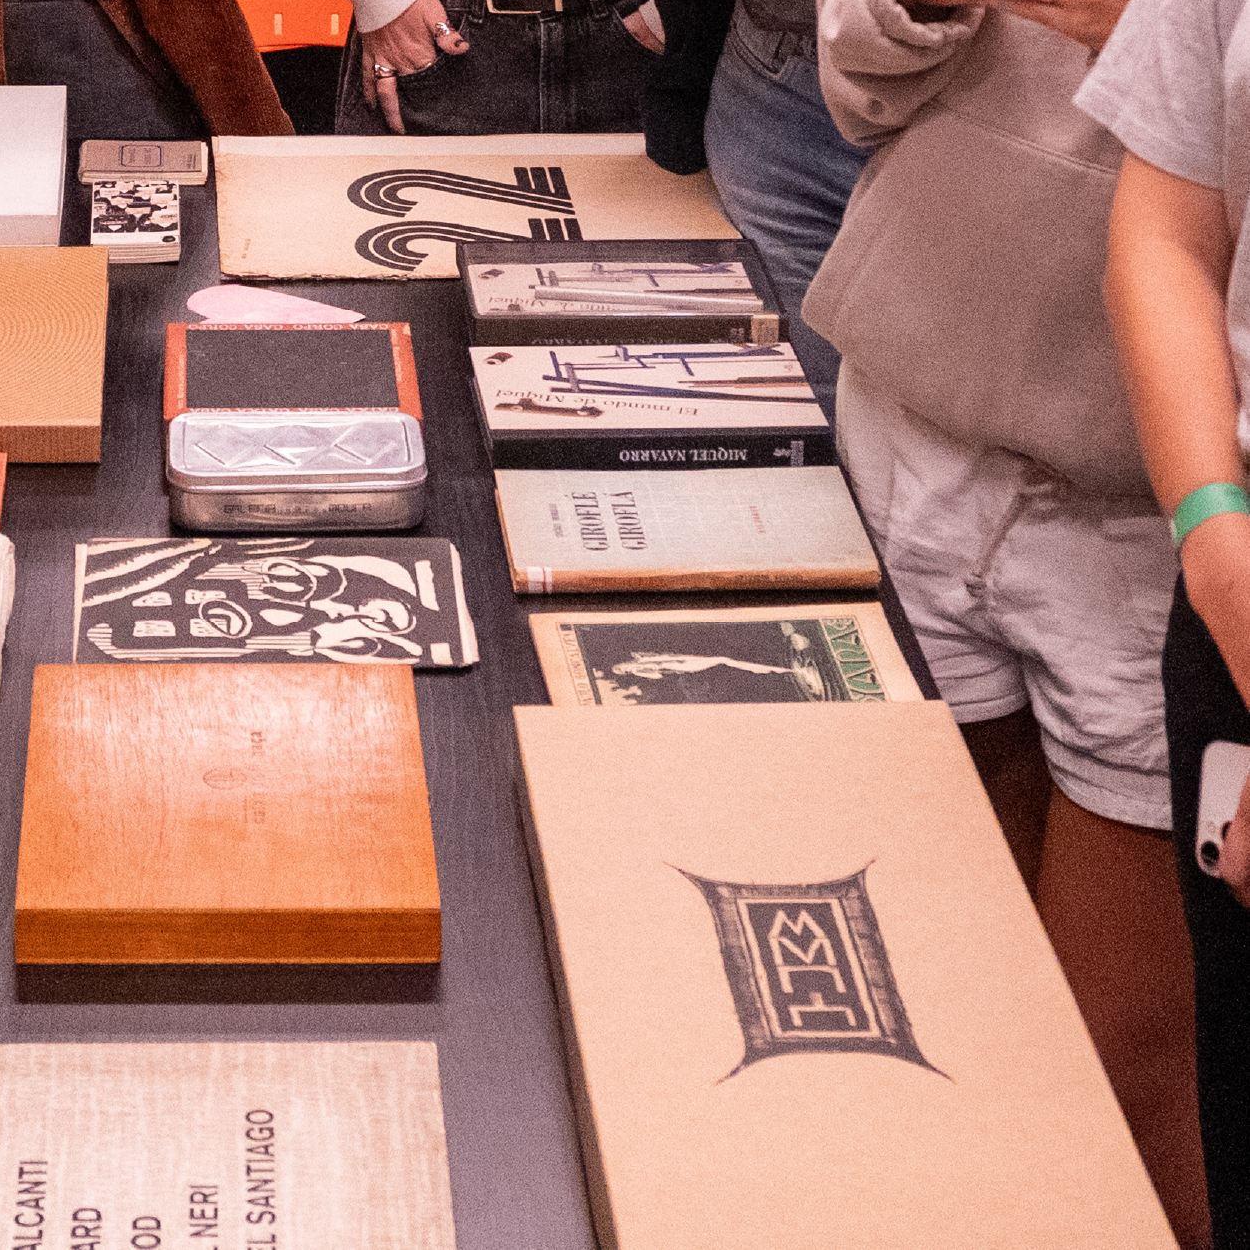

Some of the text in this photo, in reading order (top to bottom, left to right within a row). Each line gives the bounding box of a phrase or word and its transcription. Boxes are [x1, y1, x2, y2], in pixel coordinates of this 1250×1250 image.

[495, 389, 699, 416] El mundo de Miquel
[619, 446, 748, 462] MIQUEL NAVARRO
[244, 1109, 276, 1225] SANTIAGO
[188, 1185, 219, 1238] NERI
